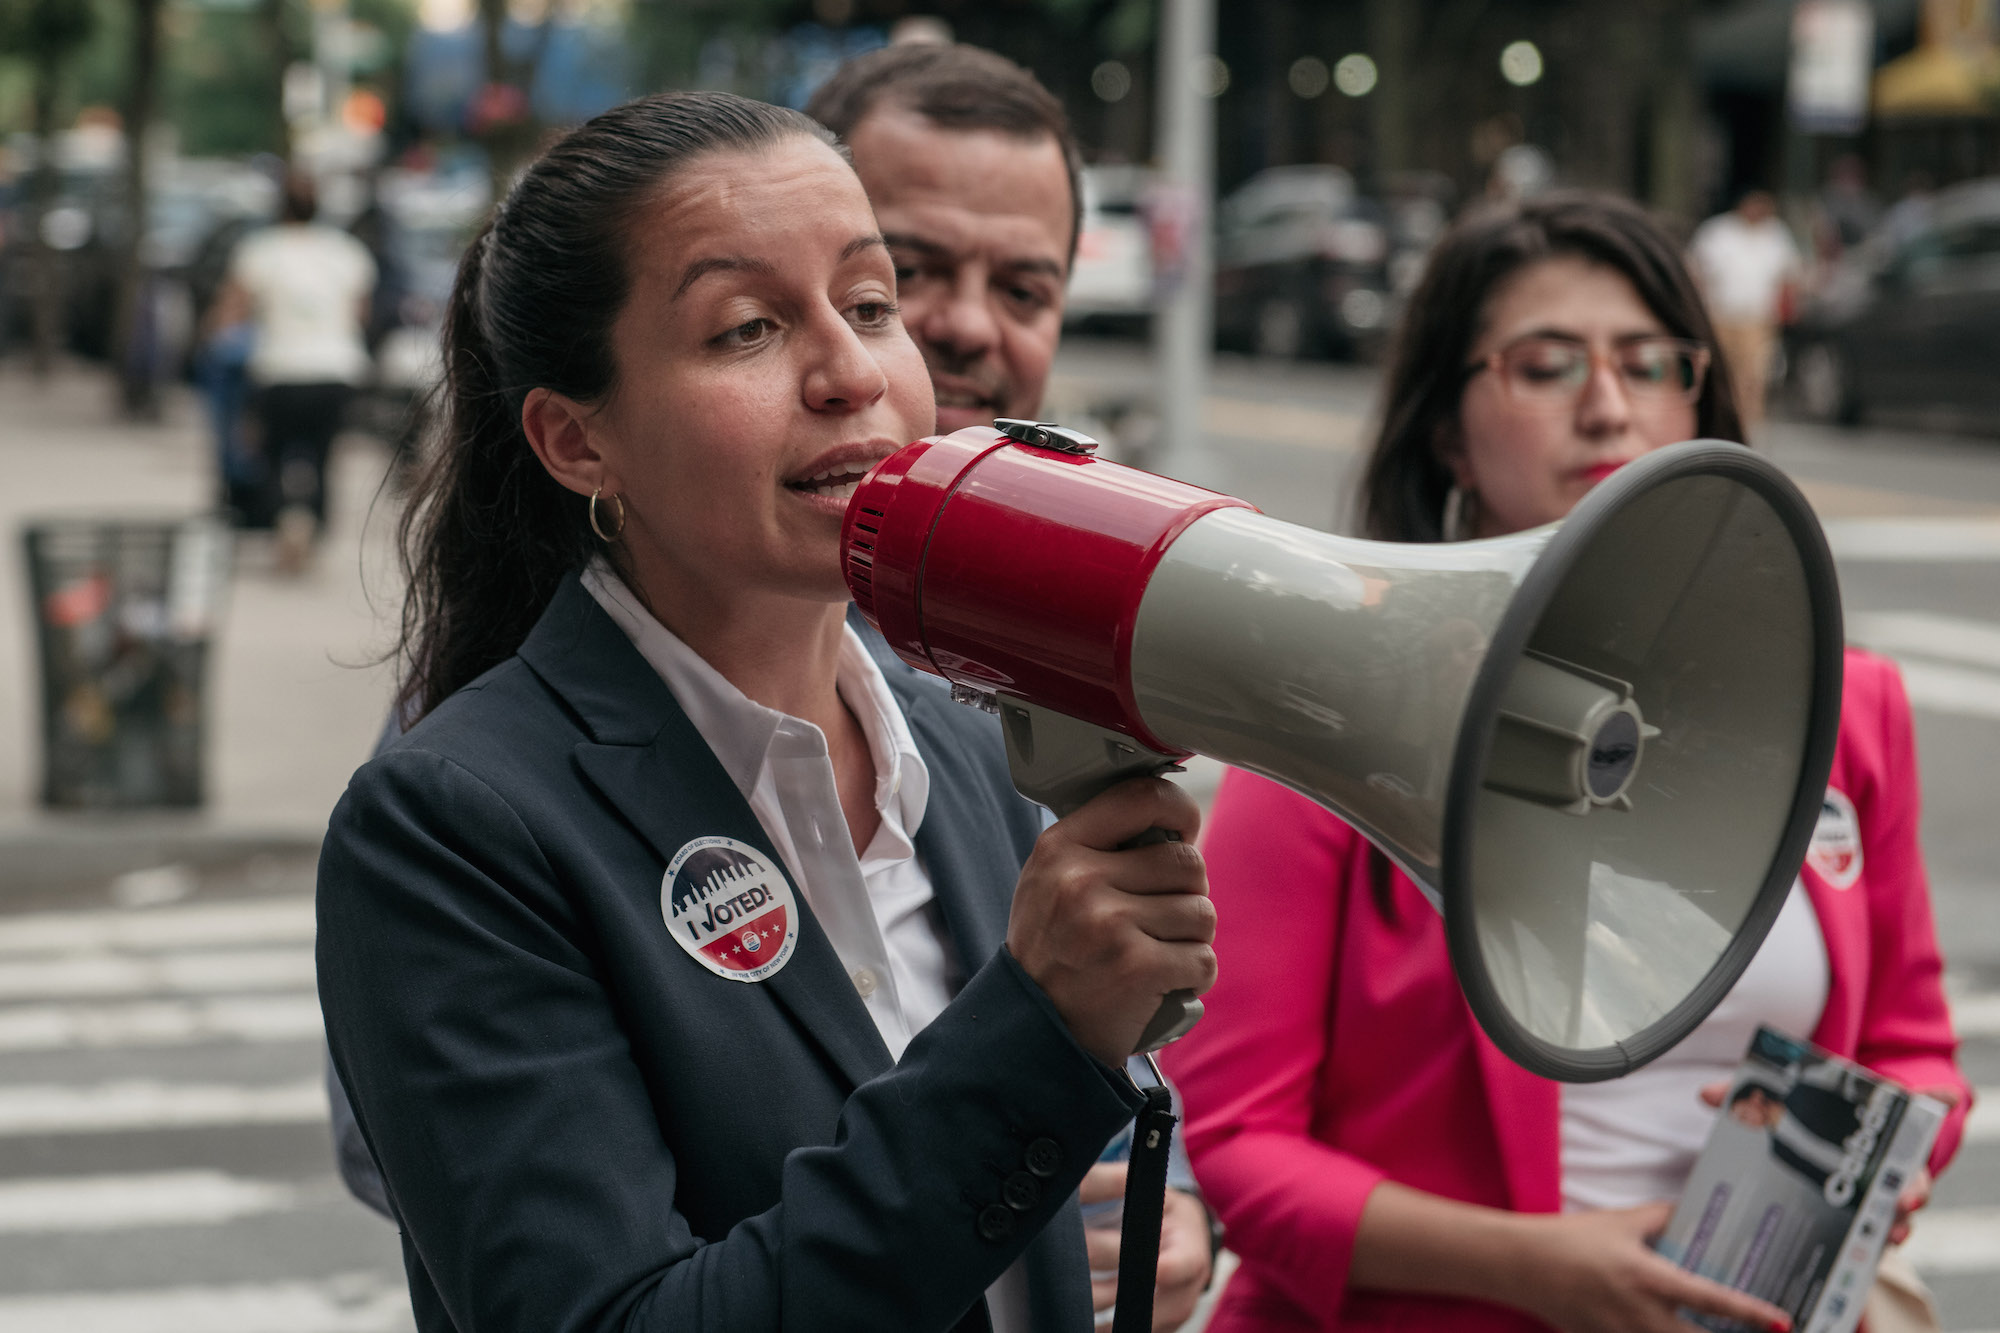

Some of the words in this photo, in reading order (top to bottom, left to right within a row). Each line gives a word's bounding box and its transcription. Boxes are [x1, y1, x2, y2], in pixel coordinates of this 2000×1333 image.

[674, 848, 688, 865] BOARD
[694, 839, 722, 847] ELECTIONS
[687, 920, 701, 940] I
[702, 883, 775, 933] VOTED!
[750, 969, 762, 977] CITY
[770, 957, 781, 968] NEW
[780, 944, 789, 958] YORK
